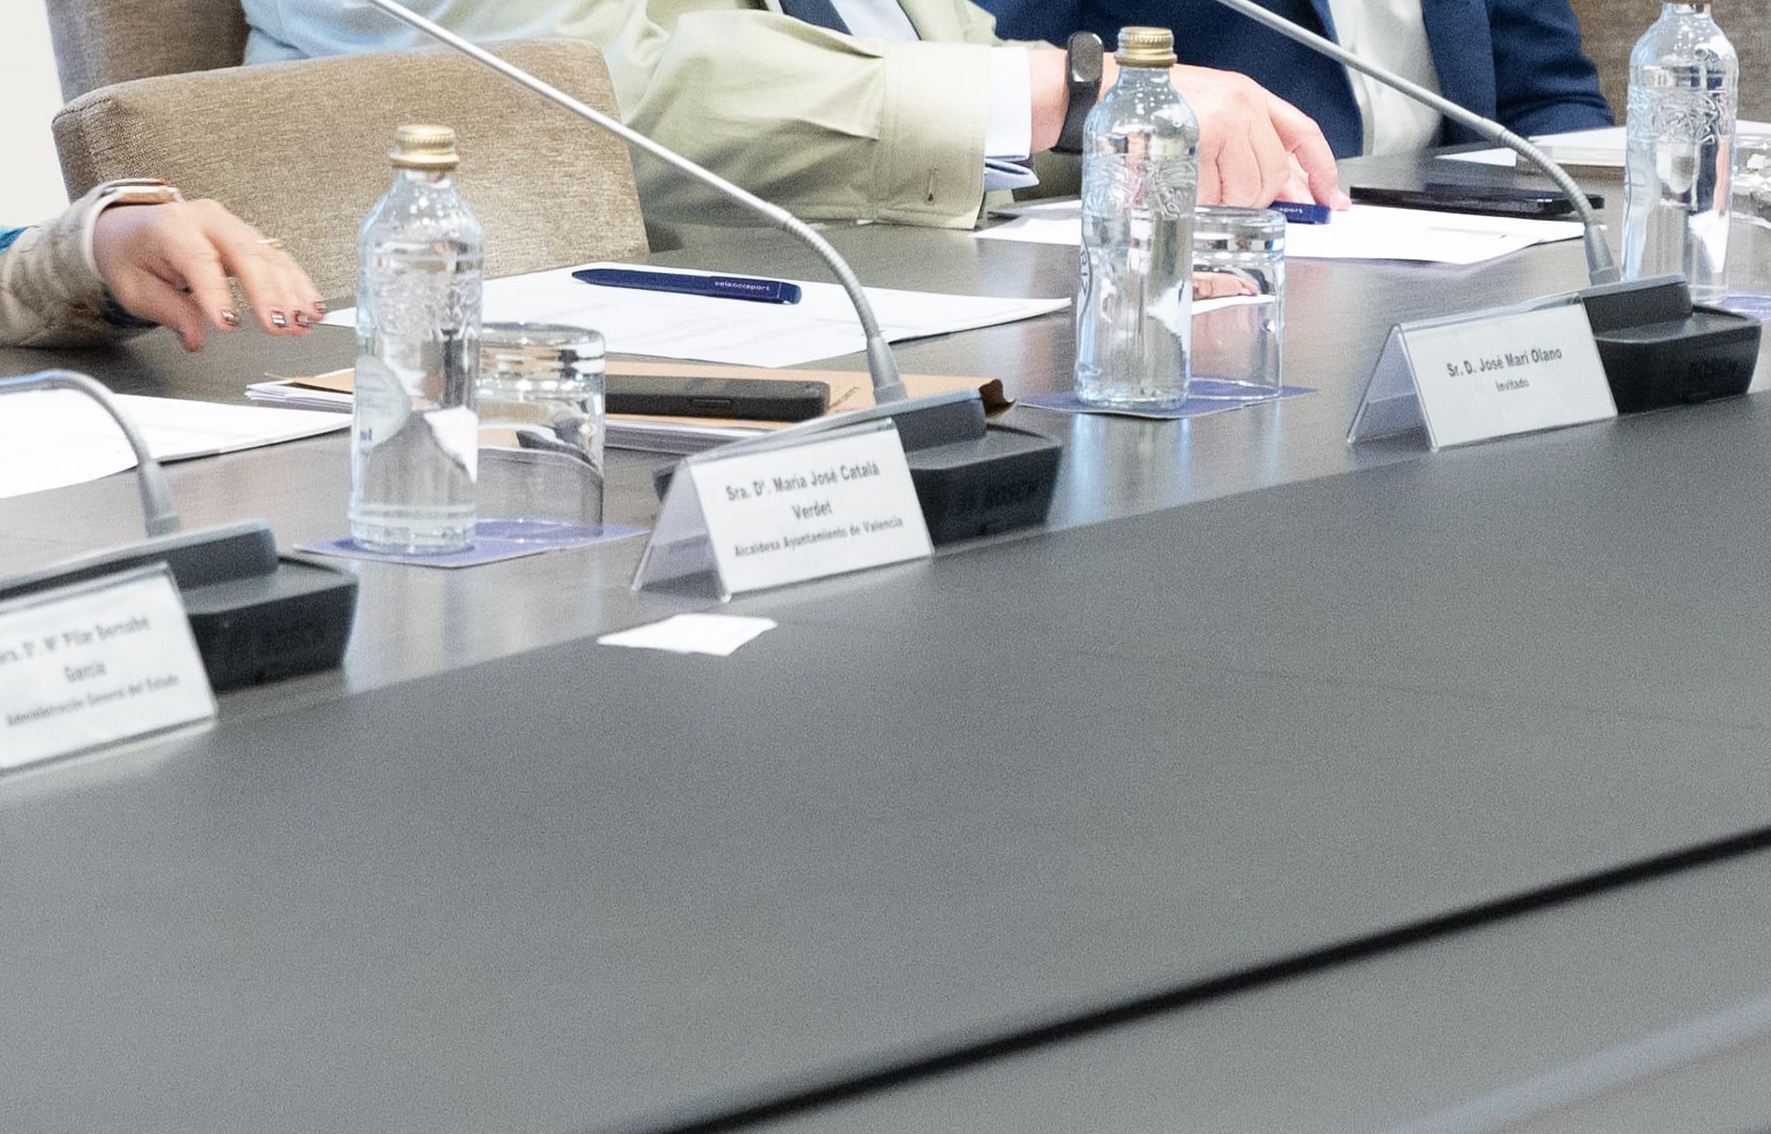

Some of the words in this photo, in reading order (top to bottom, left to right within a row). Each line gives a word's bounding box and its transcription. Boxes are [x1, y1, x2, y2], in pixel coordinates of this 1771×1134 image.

[1446, 363, 1464, 377] Sr.
[1463, 360, 1477, 374] D.
[1479, 354, 1505, 372] José
[1530, 347, 1563, 364] Olano
[1495, 377, 1530, 392] Invitado
[726, 485, 753, 502] Sra.
[811, 470, 839, 487] José
[791, 500, 833, 520] Verdet
[735, 541, 781, 558] Alcaldesa
[783, 527, 848, 551] Ayuntamiento
[849, 524, 862, 536] de
[862, 516, 904, 534] Valencia
[62, 630, 93, 647] Pilar
